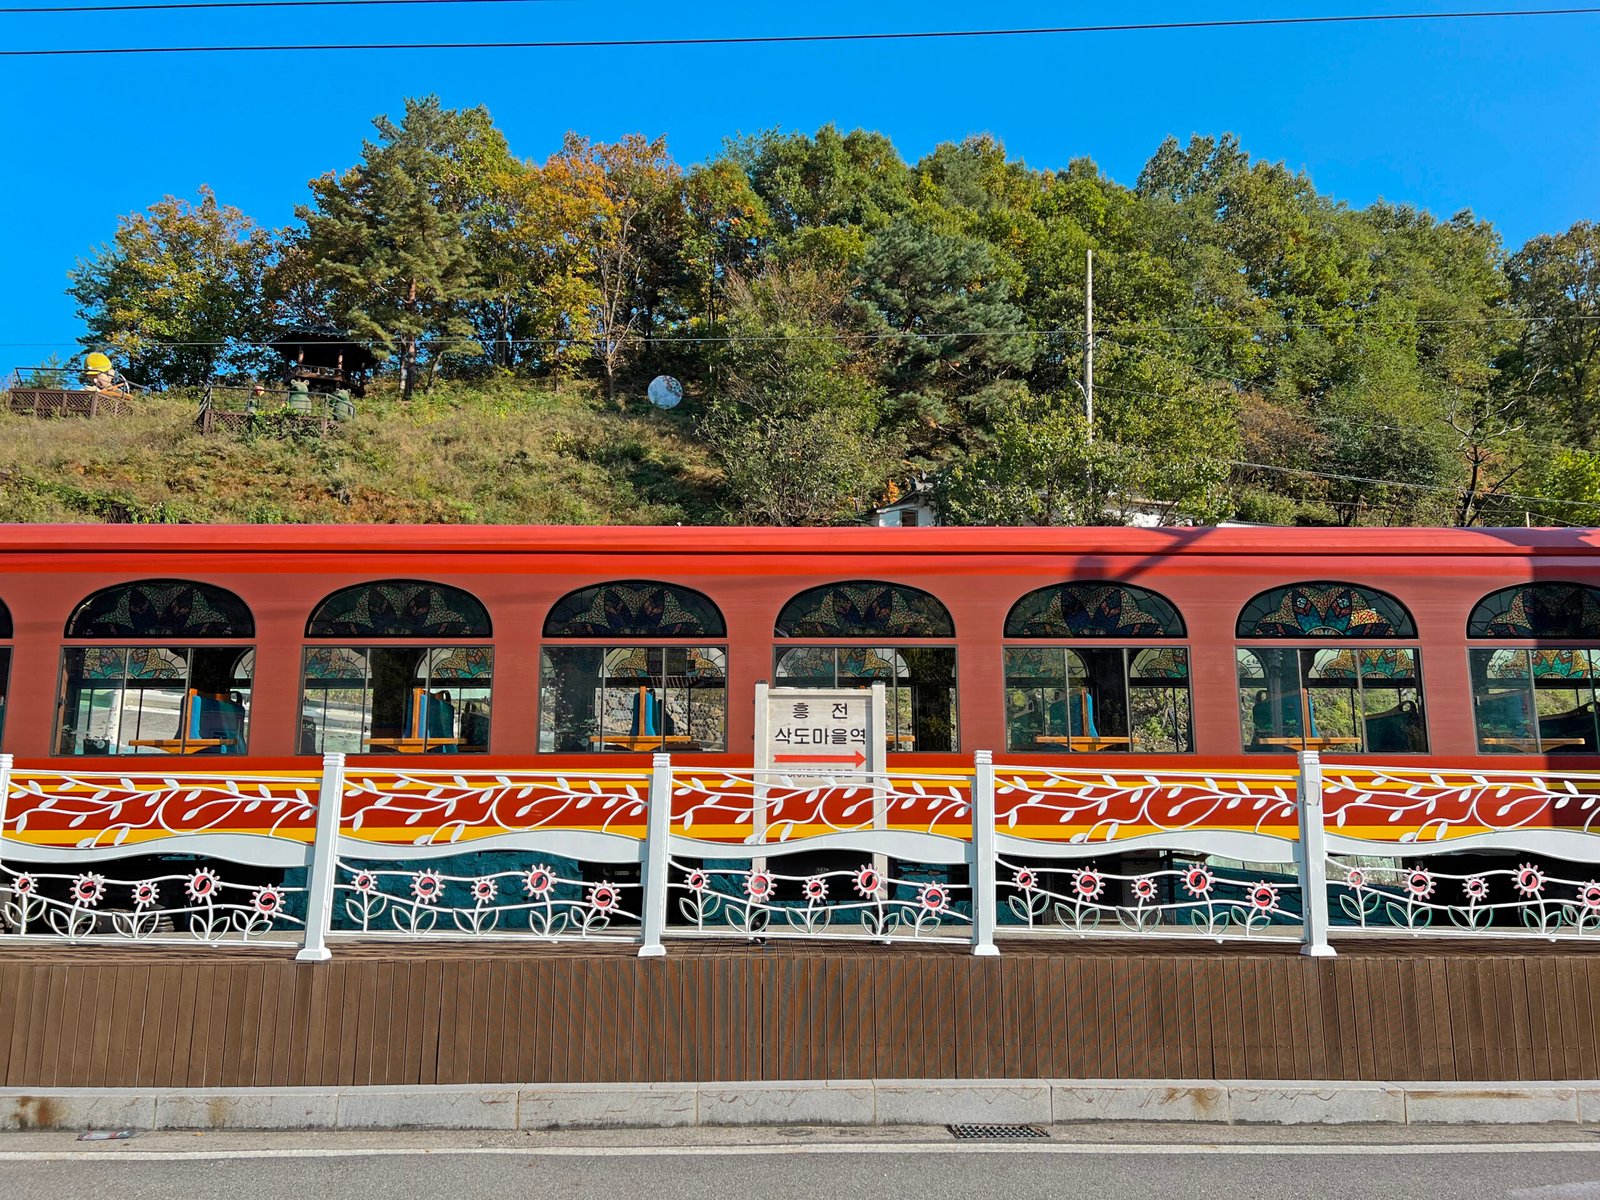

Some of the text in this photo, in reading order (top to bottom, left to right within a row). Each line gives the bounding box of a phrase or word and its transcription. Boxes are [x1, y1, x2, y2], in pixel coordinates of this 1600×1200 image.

[792, 702, 848, 720] 흥 전
[774, 727, 866, 745] 삭도마을역
